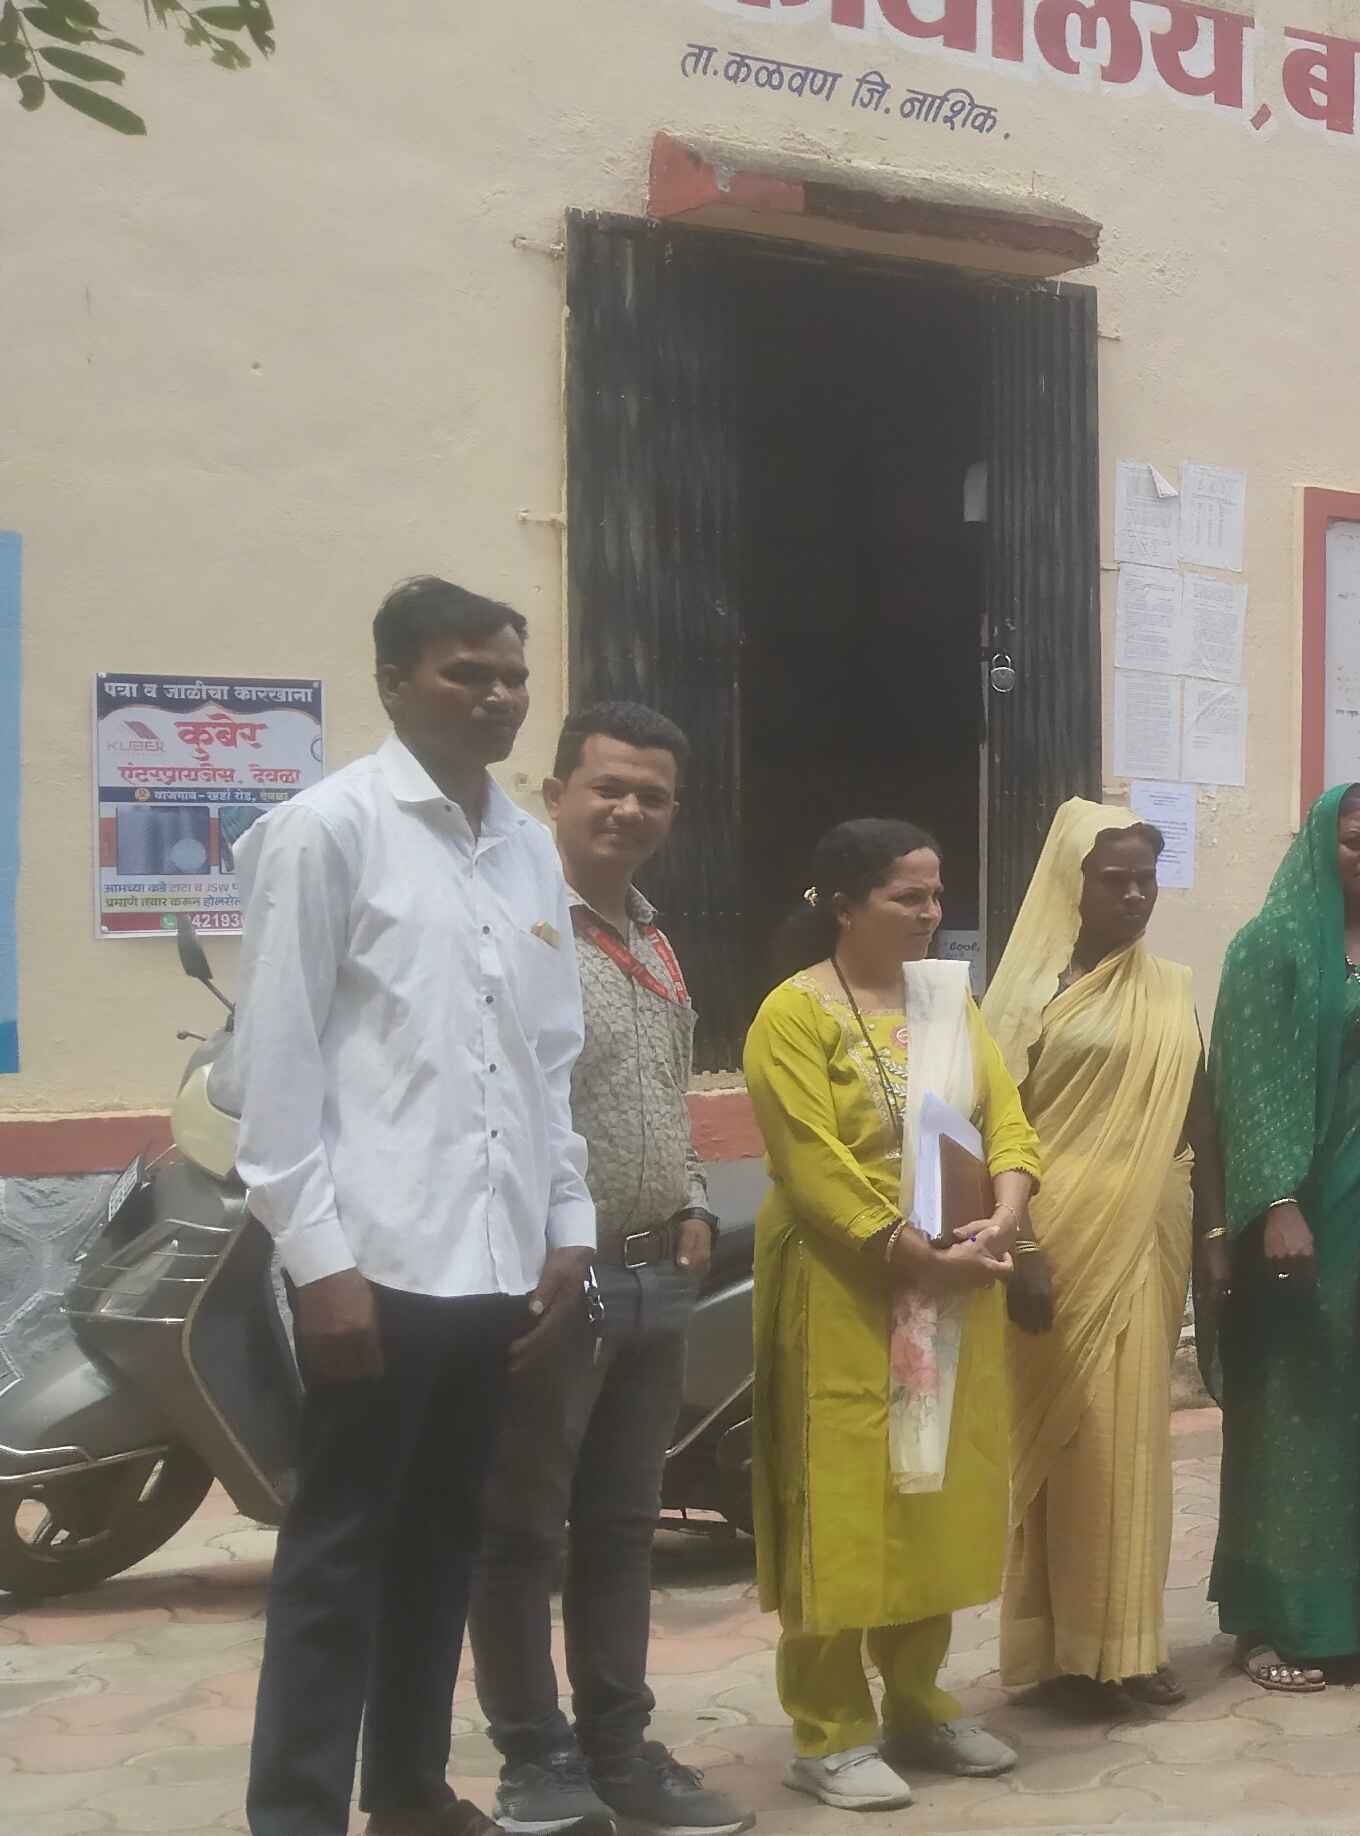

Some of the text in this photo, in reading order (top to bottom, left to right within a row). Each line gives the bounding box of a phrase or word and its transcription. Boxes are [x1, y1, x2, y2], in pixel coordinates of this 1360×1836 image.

[104, 679, 313, 702] पत्रा व जाळीचा कारखाना
[174, 713, 268, 762] कुबेर
[249, 764, 302, 785] देवळा
